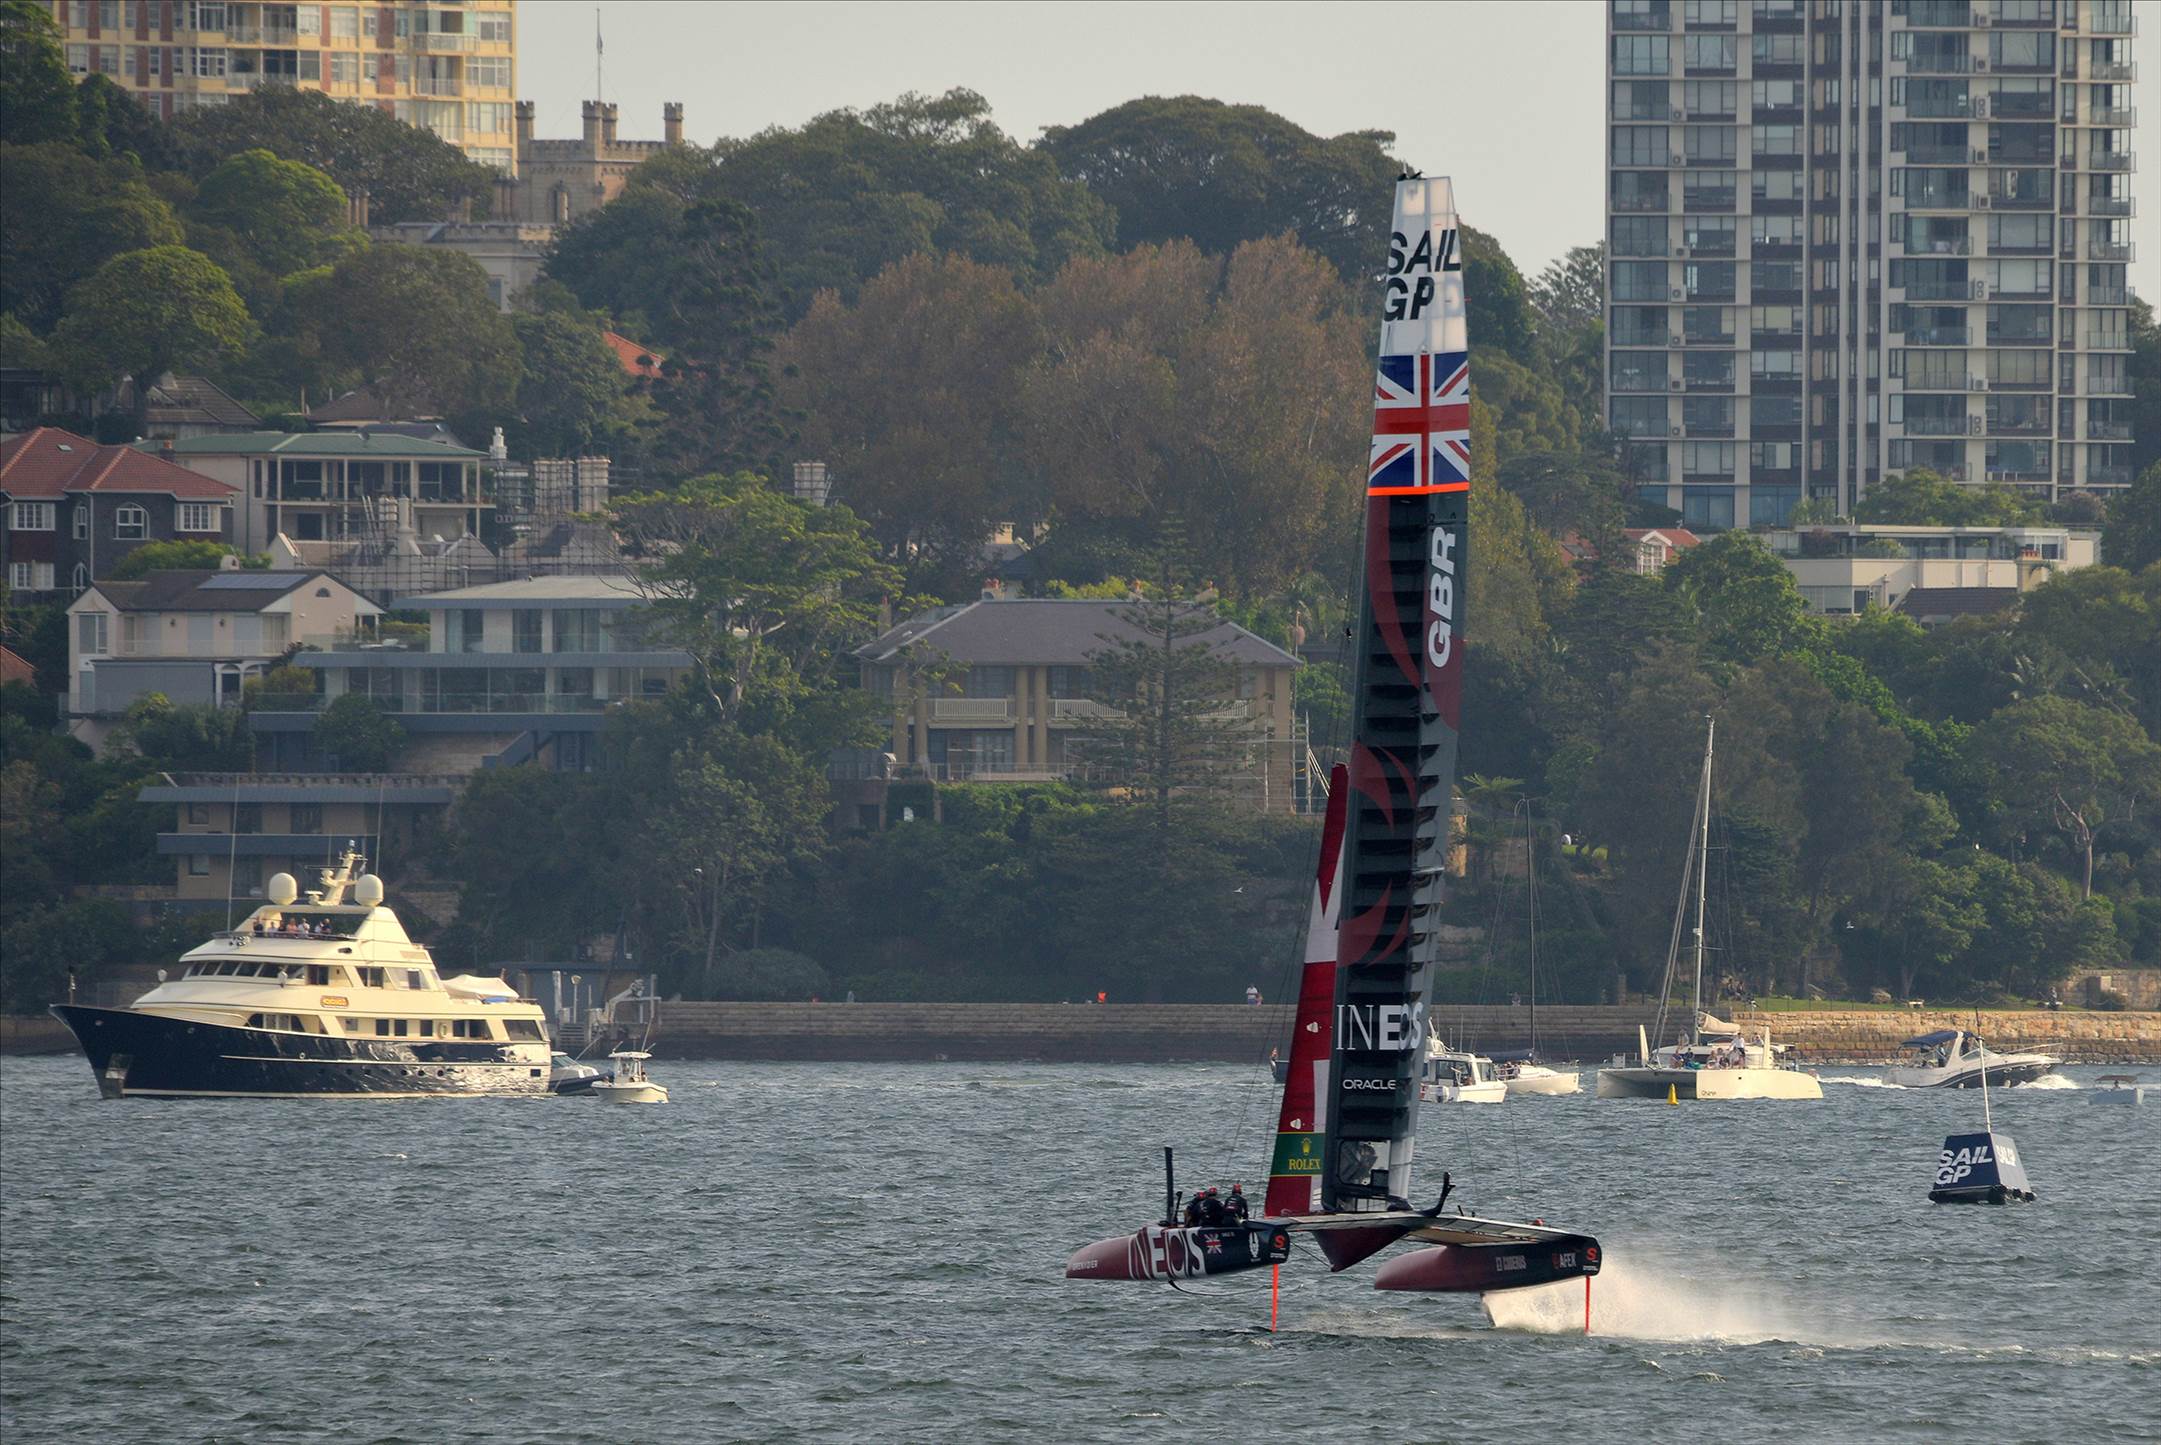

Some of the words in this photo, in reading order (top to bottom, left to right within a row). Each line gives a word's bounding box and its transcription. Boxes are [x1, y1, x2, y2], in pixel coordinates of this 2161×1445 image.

[1387, 229, 1461, 275] SAIL
[1384, 276, 1435, 322] GP
[1428, 526, 1456, 668] GBR
[1335, 1003, 1423, 1050] INEOS
[1342, 1079, 1397, 1090] ORACLE
[1288, 1158, 1321, 1170] ROLEX
[1935, 1165, 1972, 1185] GP
[1938, 1145, 1993, 1168] SAIL
[1128, 1226, 1206, 1280] INEOS
